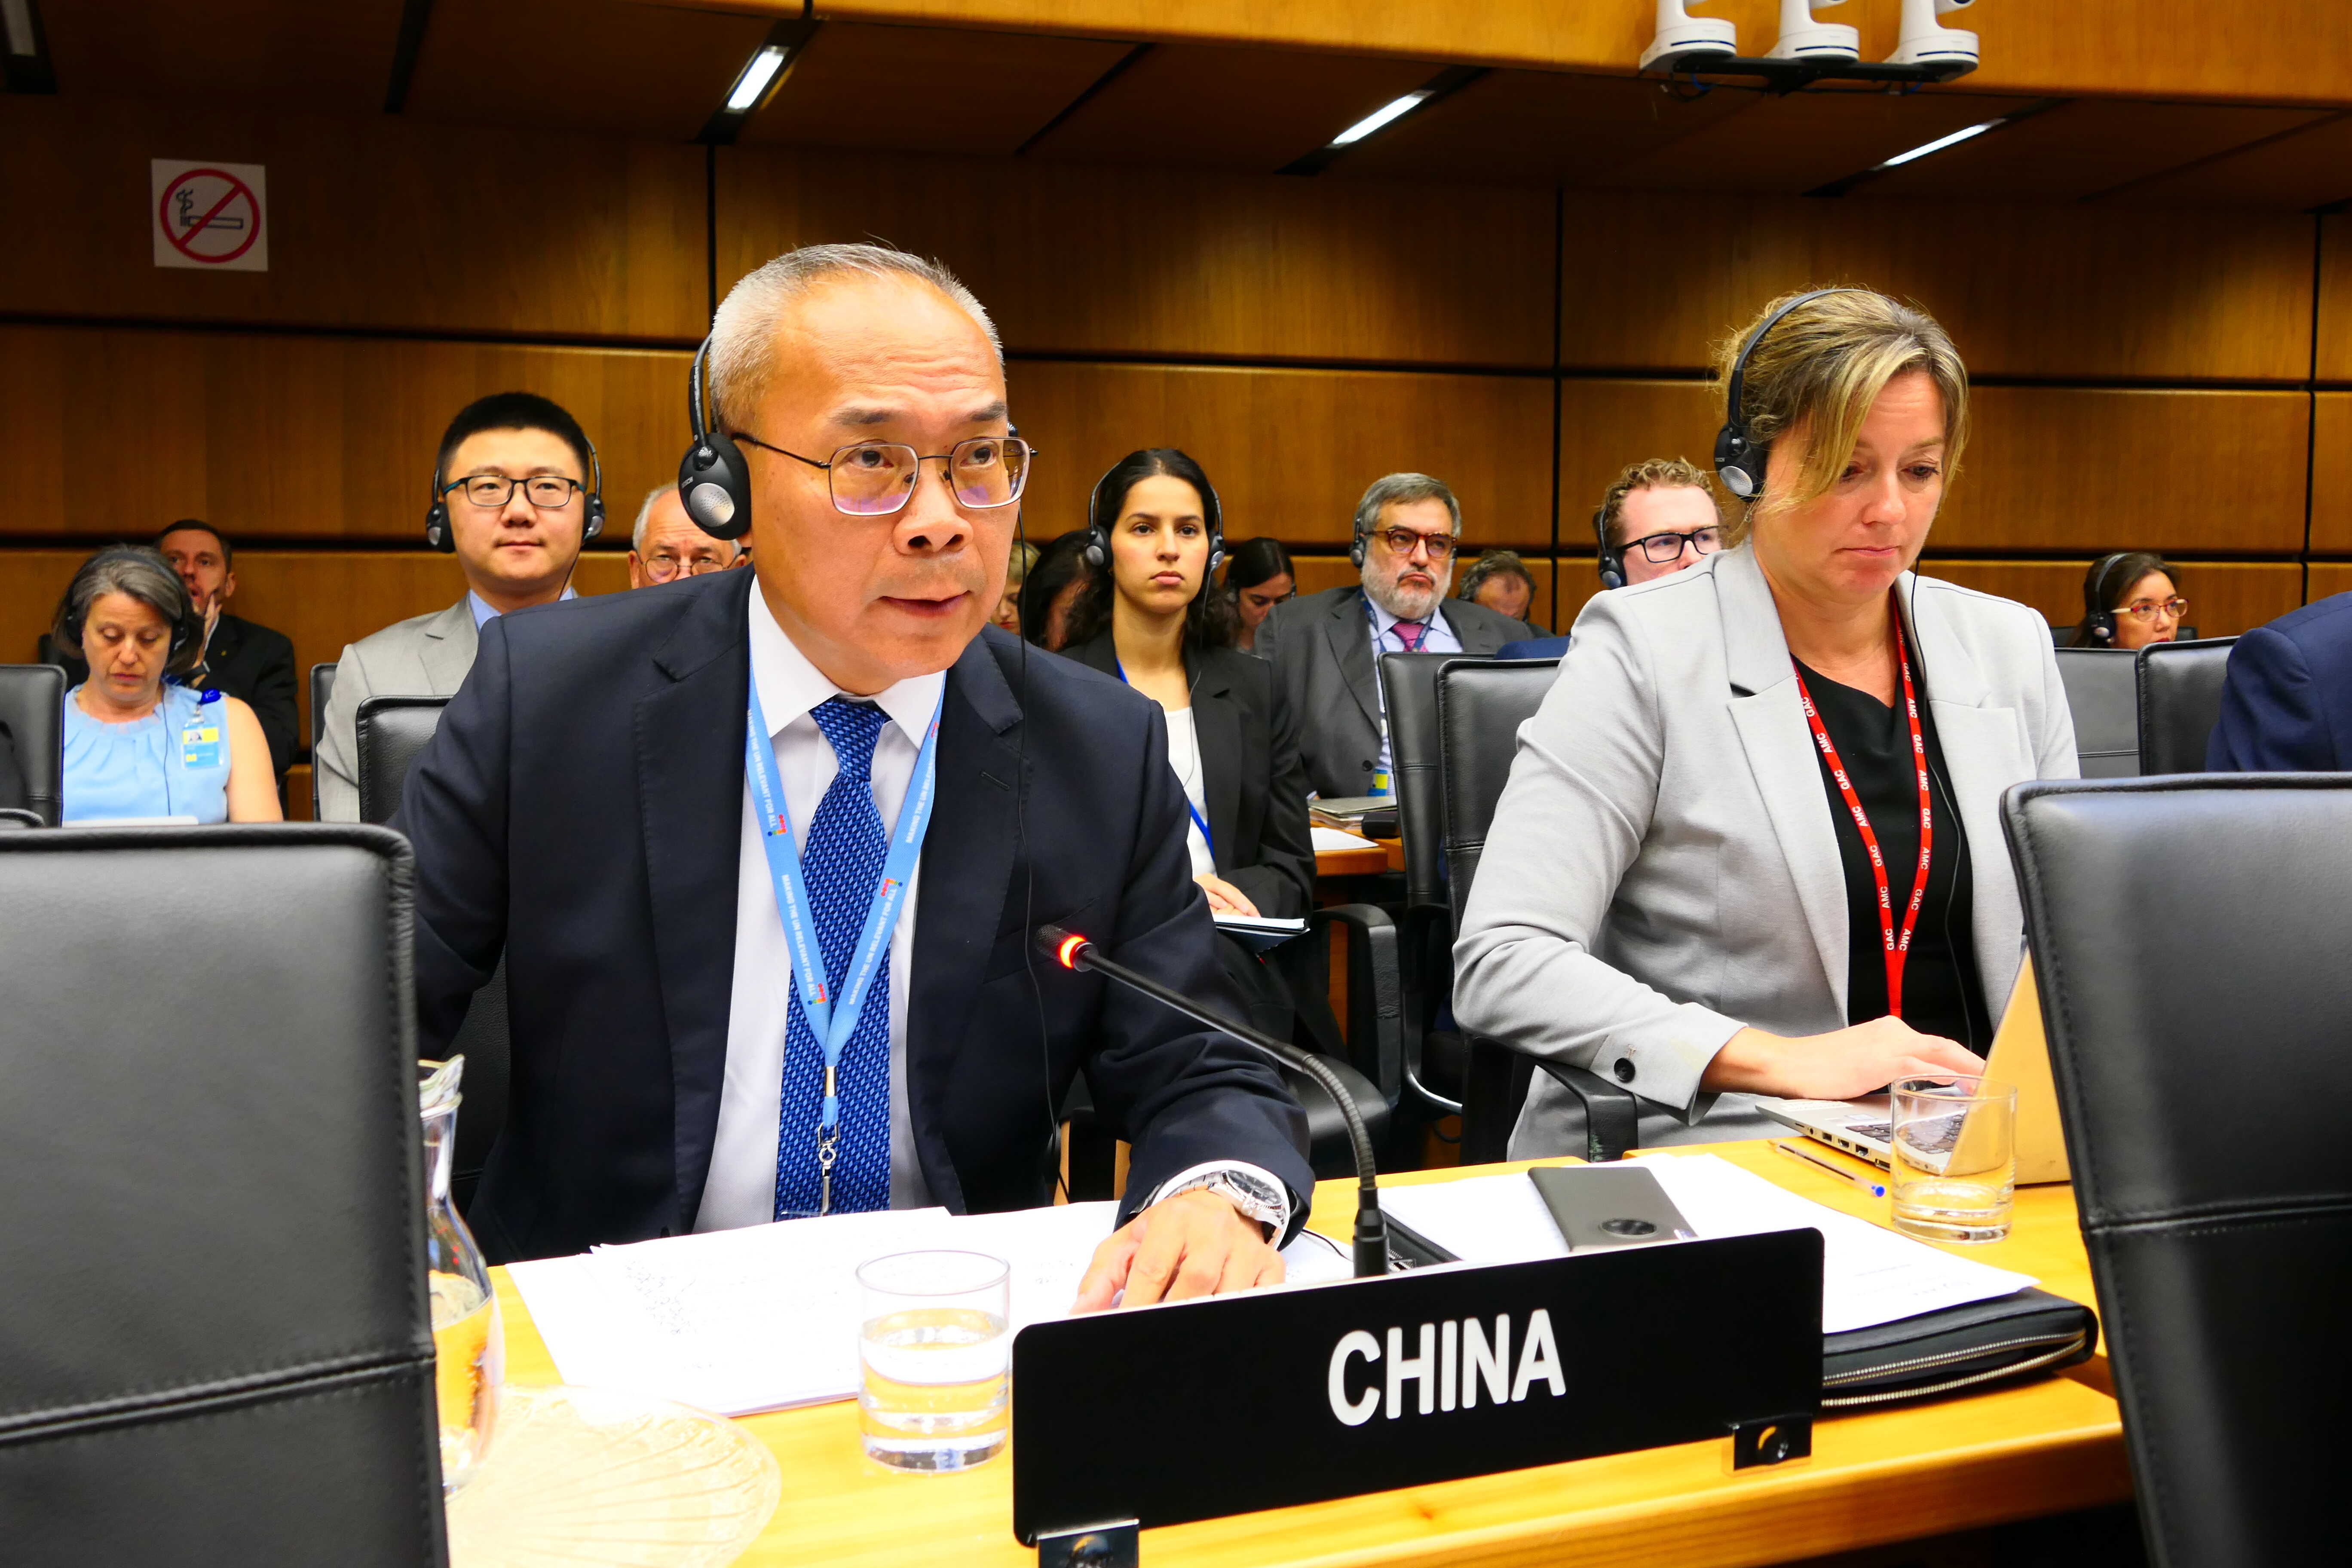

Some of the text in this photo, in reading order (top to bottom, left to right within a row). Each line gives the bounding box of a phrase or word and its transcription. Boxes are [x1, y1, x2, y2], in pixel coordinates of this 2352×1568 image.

[1908, 698, 1917, 718] AMC
[1913, 734, 1923, 753] GAC
[753, 751, 762, 762] UN
[756, 762, 771, 798] RELEVANT
[1918, 770, 1929, 791] AMC
[764, 798, 774, 814] FOR
[919, 790, 927, 801] UN
[914, 800, 925, 814] THE
[768, 813, 777, 828] ALL
[905, 815, 920, 843] MAKING
[1802, 697, 1894, 950] GAC AMC GAC AMC GAC AMC GAC
[1920, 847, 1929, 870] AMC
[1911, 889, 1922, 910] GAC
[781, 874, 817, 997] MAKING THE UN RELEVANT FOR ALL
[1899, 928, 1911, 951] AMC
[848, 888, 897, 1005] MAKING THE UN RELEVANT FOR ALL
[1328, 1308, 1566, 1426] CHINA
